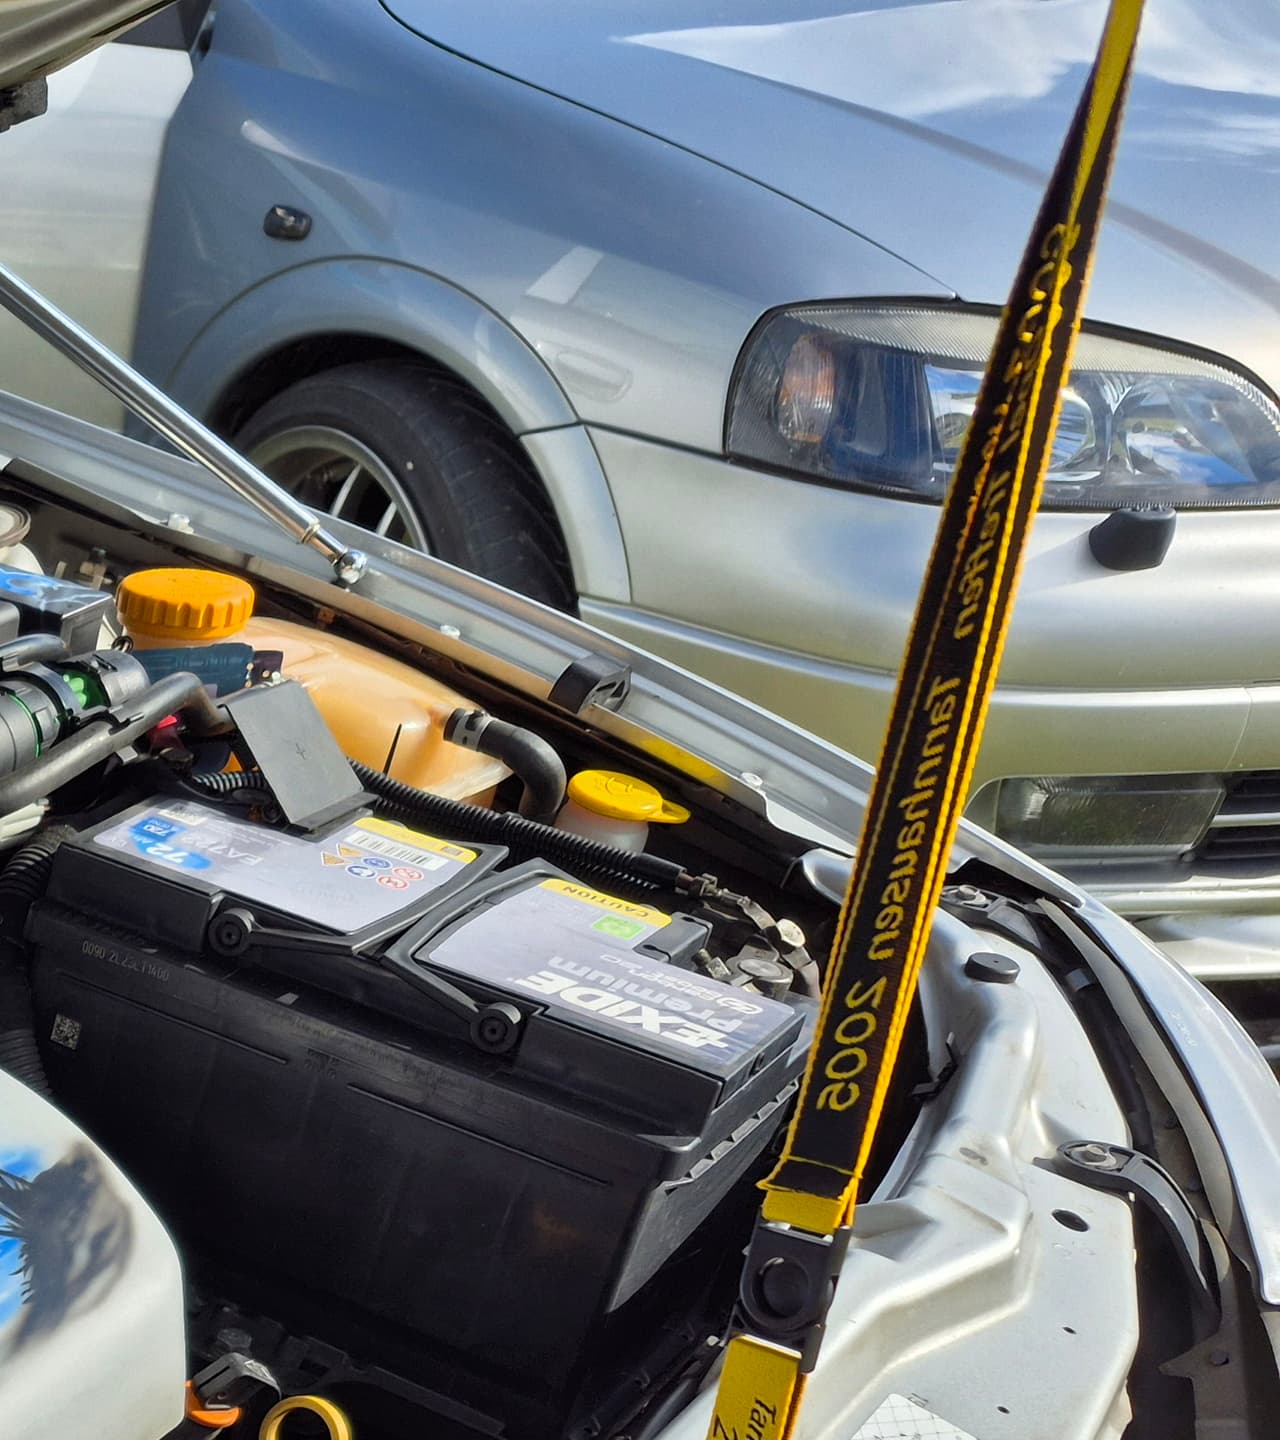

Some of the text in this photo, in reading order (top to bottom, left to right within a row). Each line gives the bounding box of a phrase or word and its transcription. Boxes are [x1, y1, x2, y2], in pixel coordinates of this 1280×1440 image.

[146, 842, 189, 864] 72
[562, 885, 653, 919] CAUTION
[516, 969, 729, 1049] EXIDE
[548, 955, 743, 1033] Premium
